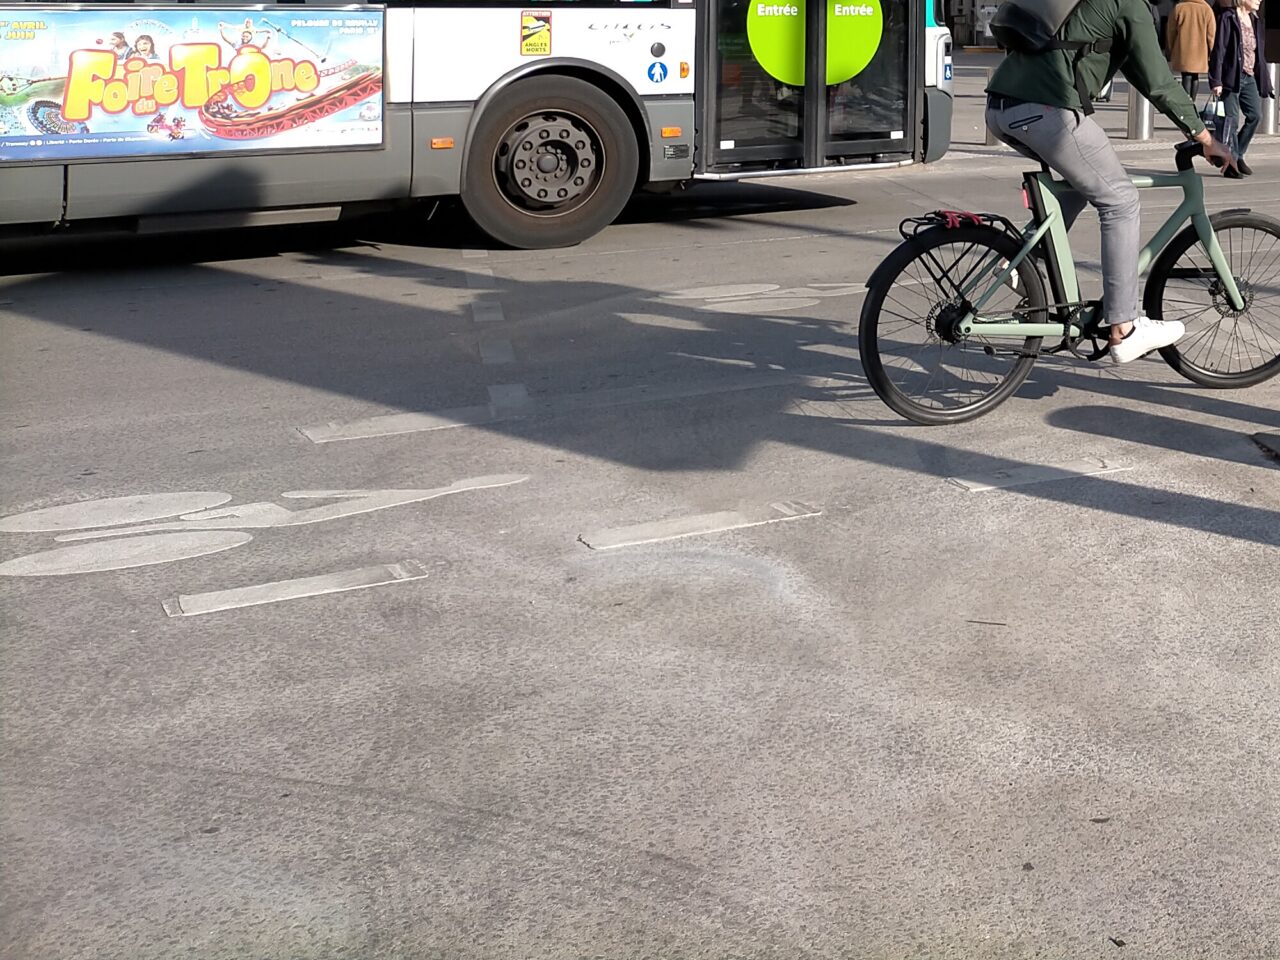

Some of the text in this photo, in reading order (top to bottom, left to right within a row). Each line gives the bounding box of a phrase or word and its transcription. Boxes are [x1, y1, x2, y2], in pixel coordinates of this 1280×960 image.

[757, 3, 798, 17] Entrée
[834, 3, 874, 17] Entrée
[62, 48, 179, 122] Foire
[134, 98, 157, 115] du
